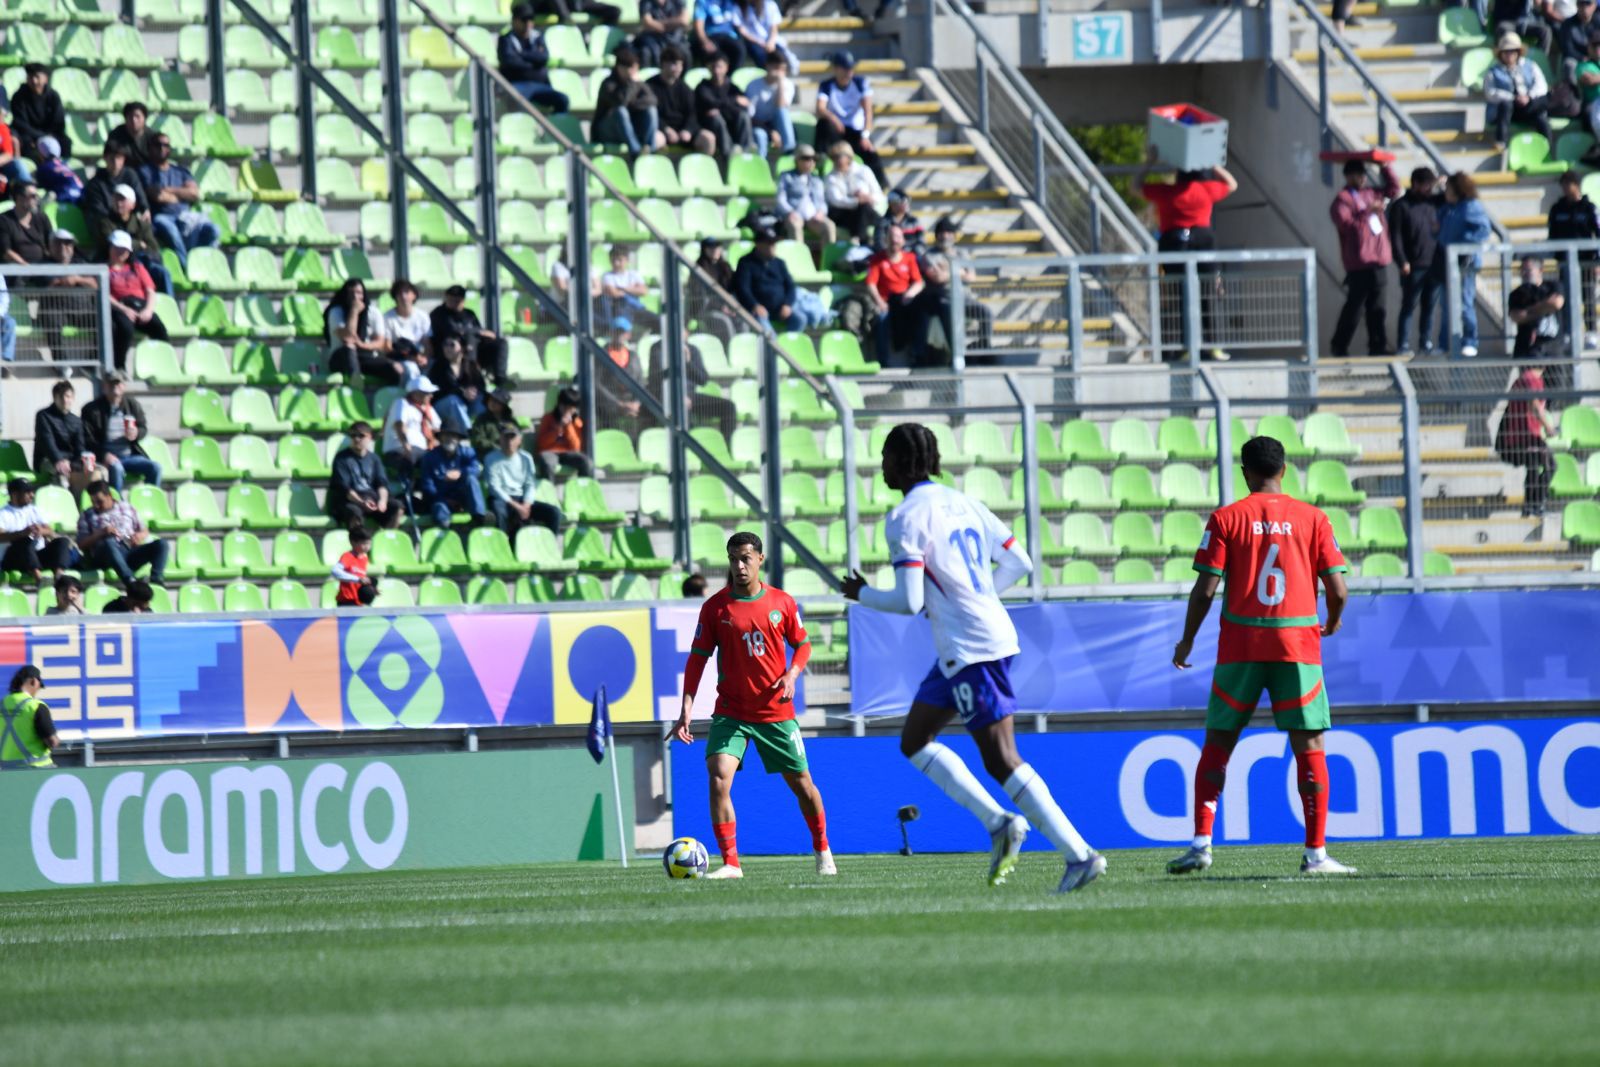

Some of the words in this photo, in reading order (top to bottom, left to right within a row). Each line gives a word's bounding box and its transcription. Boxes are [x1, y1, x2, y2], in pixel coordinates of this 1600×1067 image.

[1078, 21, 1120, 54] S7
[1252, 521, 1292, 535] BYAR
[1257, 543, 1286, 606] 6
[742, 630, 766, 657] 18
[952, 682, 974, 715] 19
[31, 762, 409, 884] aramco
